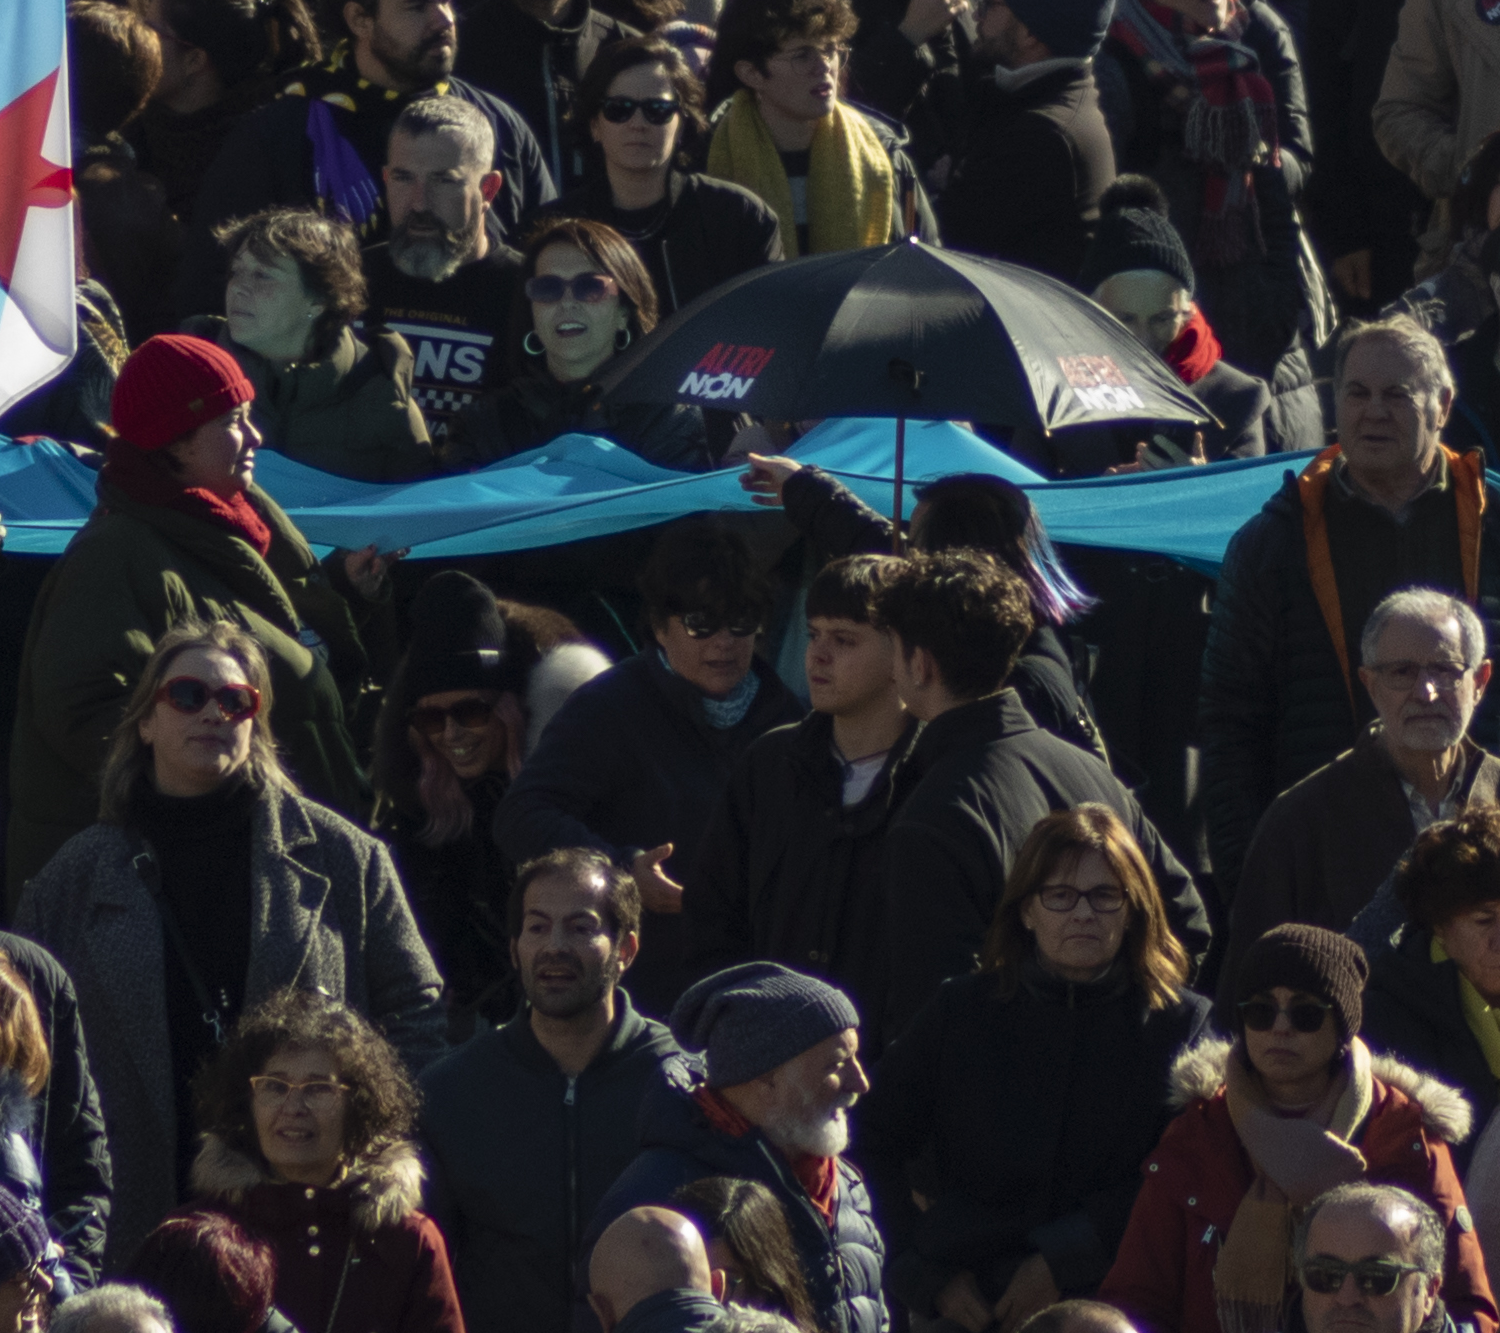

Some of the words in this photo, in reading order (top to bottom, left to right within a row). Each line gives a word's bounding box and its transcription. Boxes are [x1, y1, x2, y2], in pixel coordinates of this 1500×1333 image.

[383, 307, 404, 318] THE
[407, 308, 468, 326] ORIGINAL
[414, 339, 486, 383] NS
[694, 341, 776, 378] ALTRI
[677, 371, 755, 400] NON
[1073, 384, 1146, 412] NON
